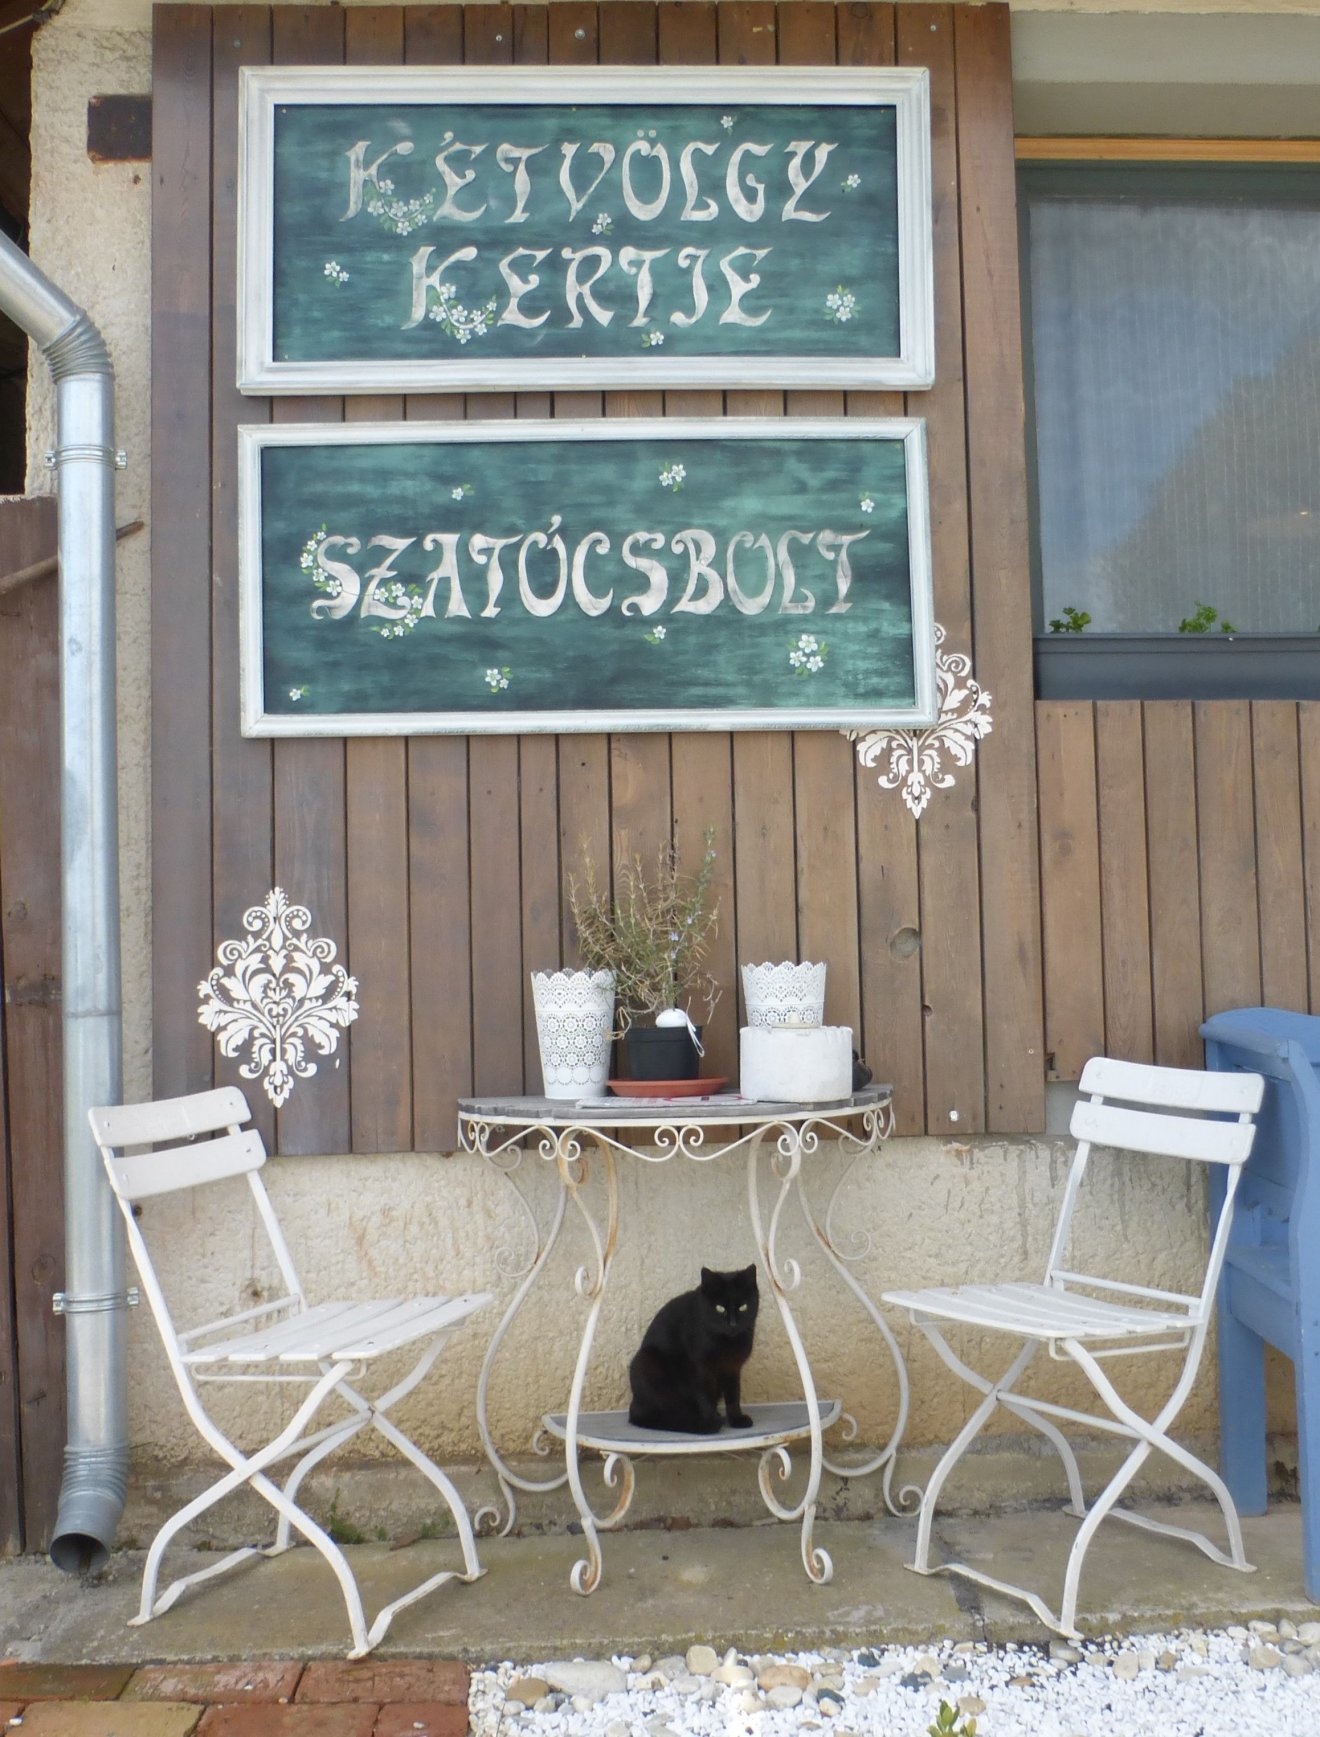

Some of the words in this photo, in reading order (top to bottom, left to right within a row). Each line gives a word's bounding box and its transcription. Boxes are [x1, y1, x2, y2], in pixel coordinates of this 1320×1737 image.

[339, 130, 839, 223] KÉTVÖLGY
[400, 246, 773, 330] KERTJE
[310, 514, 871, 620] SZATÓCSBOLT
